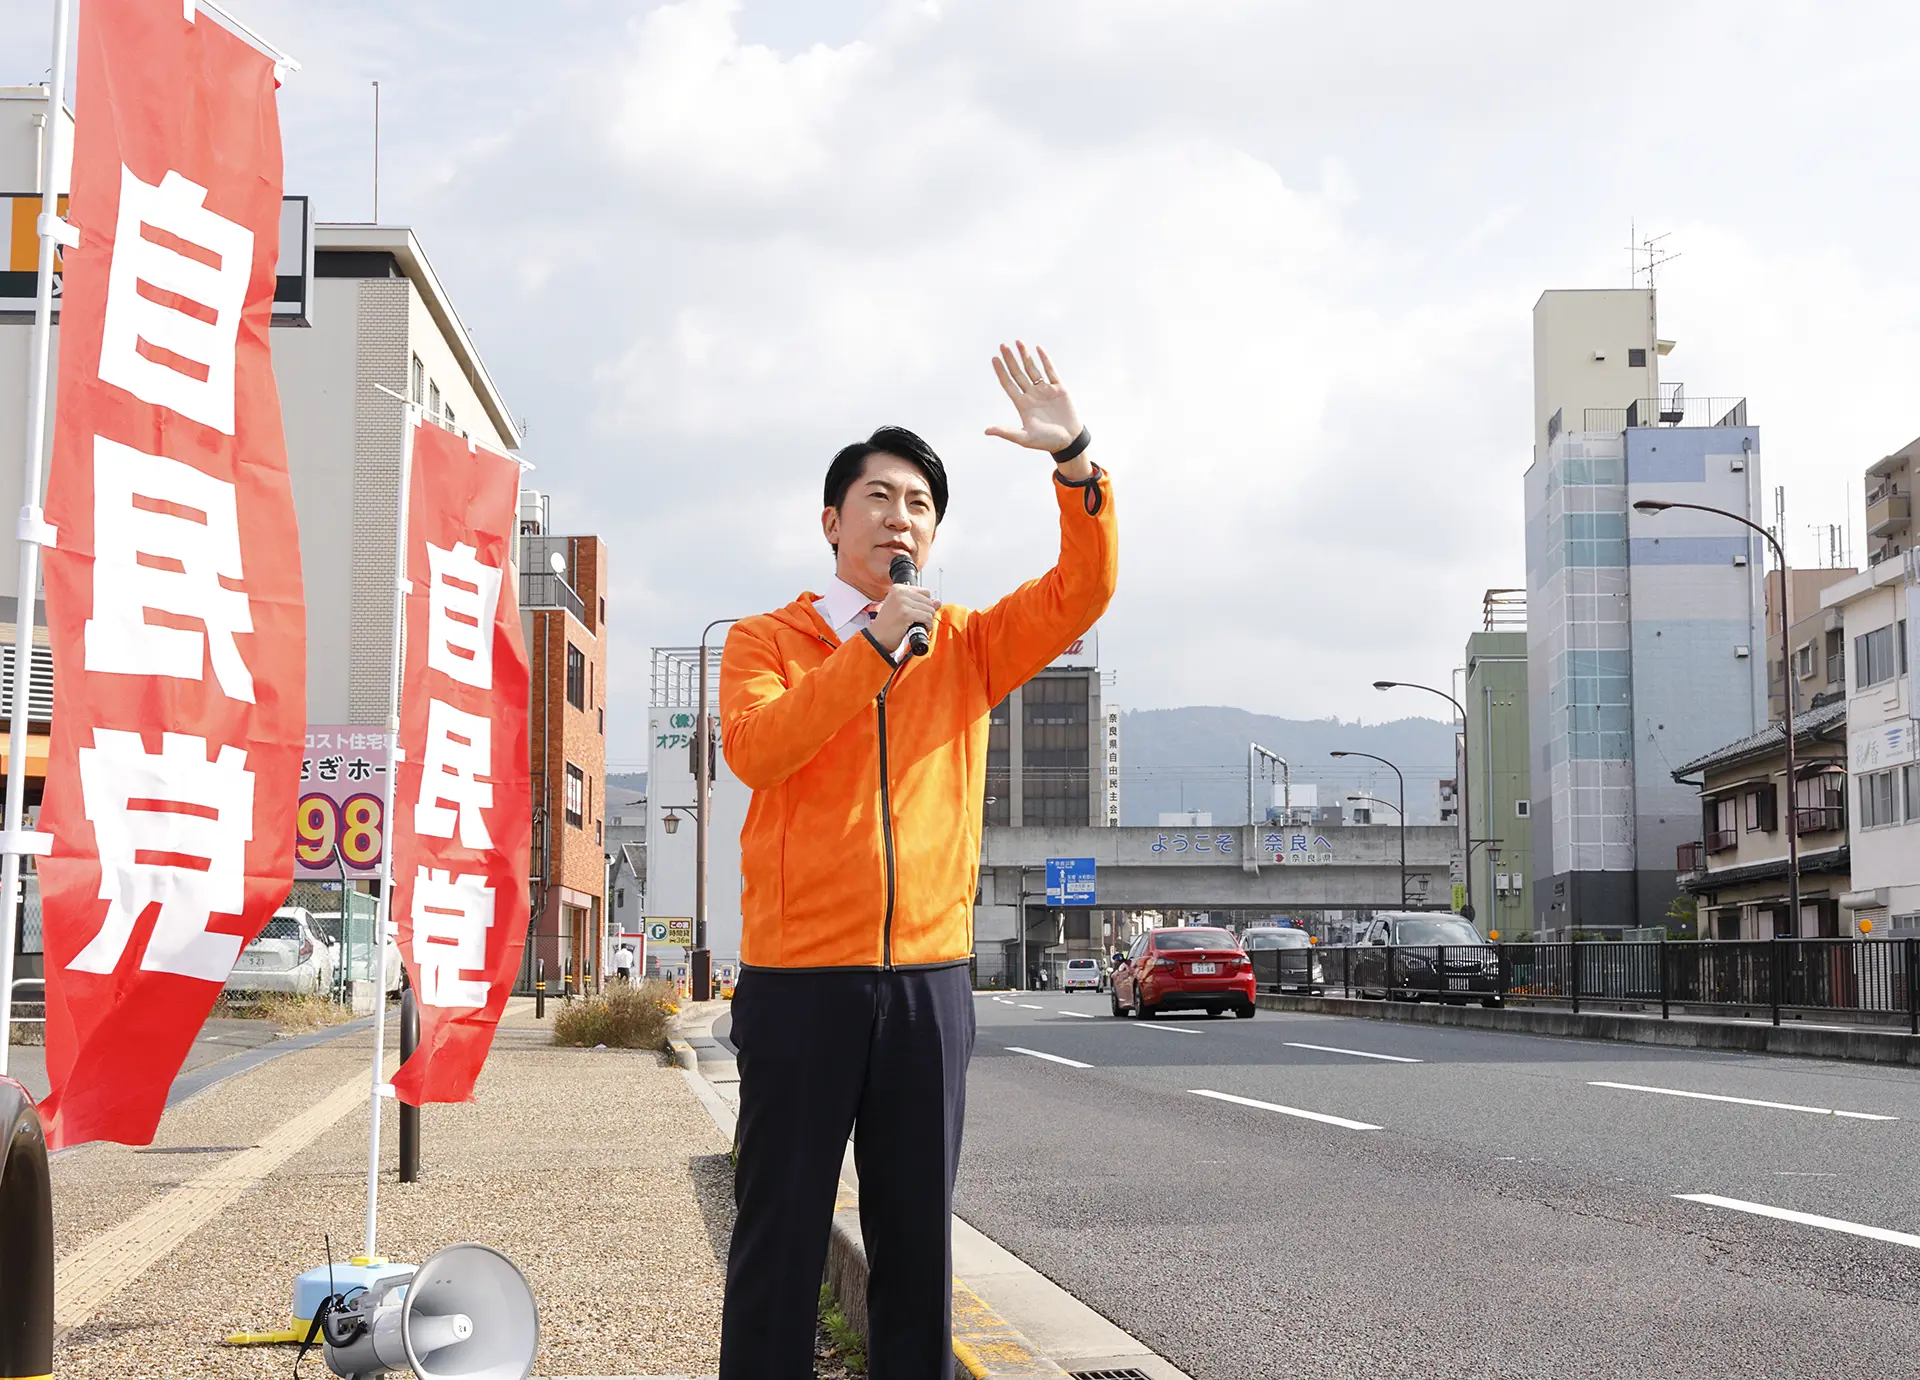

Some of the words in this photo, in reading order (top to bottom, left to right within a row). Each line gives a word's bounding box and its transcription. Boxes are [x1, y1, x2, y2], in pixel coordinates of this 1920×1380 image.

[65, 161, 257, 982] 自民党
[411, 540, 503, 1009] 自民党
[1151, 834, 1234, 853] ようこそ
[1264, 833, 1332, 852] 奈良へ
[1291, 854, 1332, 863] 奈良県
